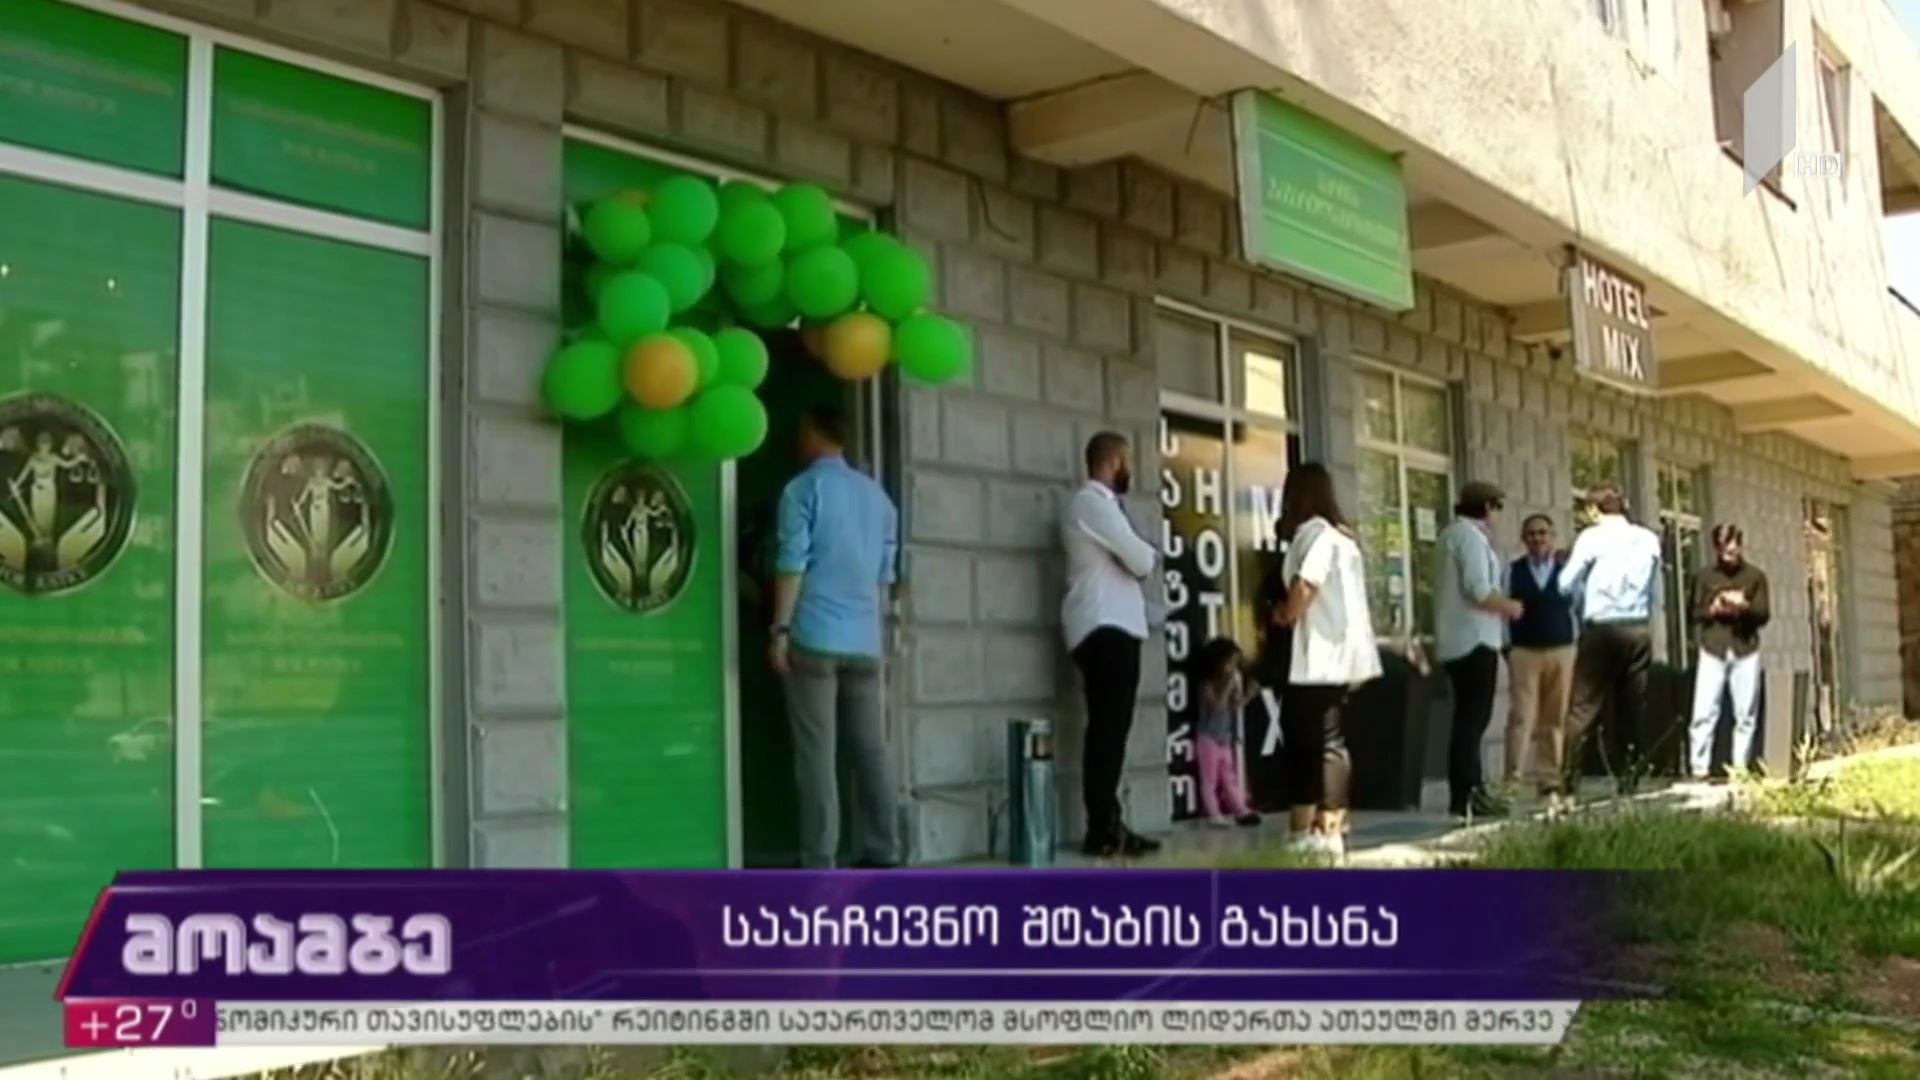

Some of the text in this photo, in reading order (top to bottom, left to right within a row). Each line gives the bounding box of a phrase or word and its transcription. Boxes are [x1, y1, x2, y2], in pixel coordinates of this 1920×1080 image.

[1583, 259, 1649, 330] HOTEL
[1602, 325, 1644, 381] MIX
[1195, 467, 1225, 639] HOT
[1158, 416, 1197, 815] სასტუმრო
